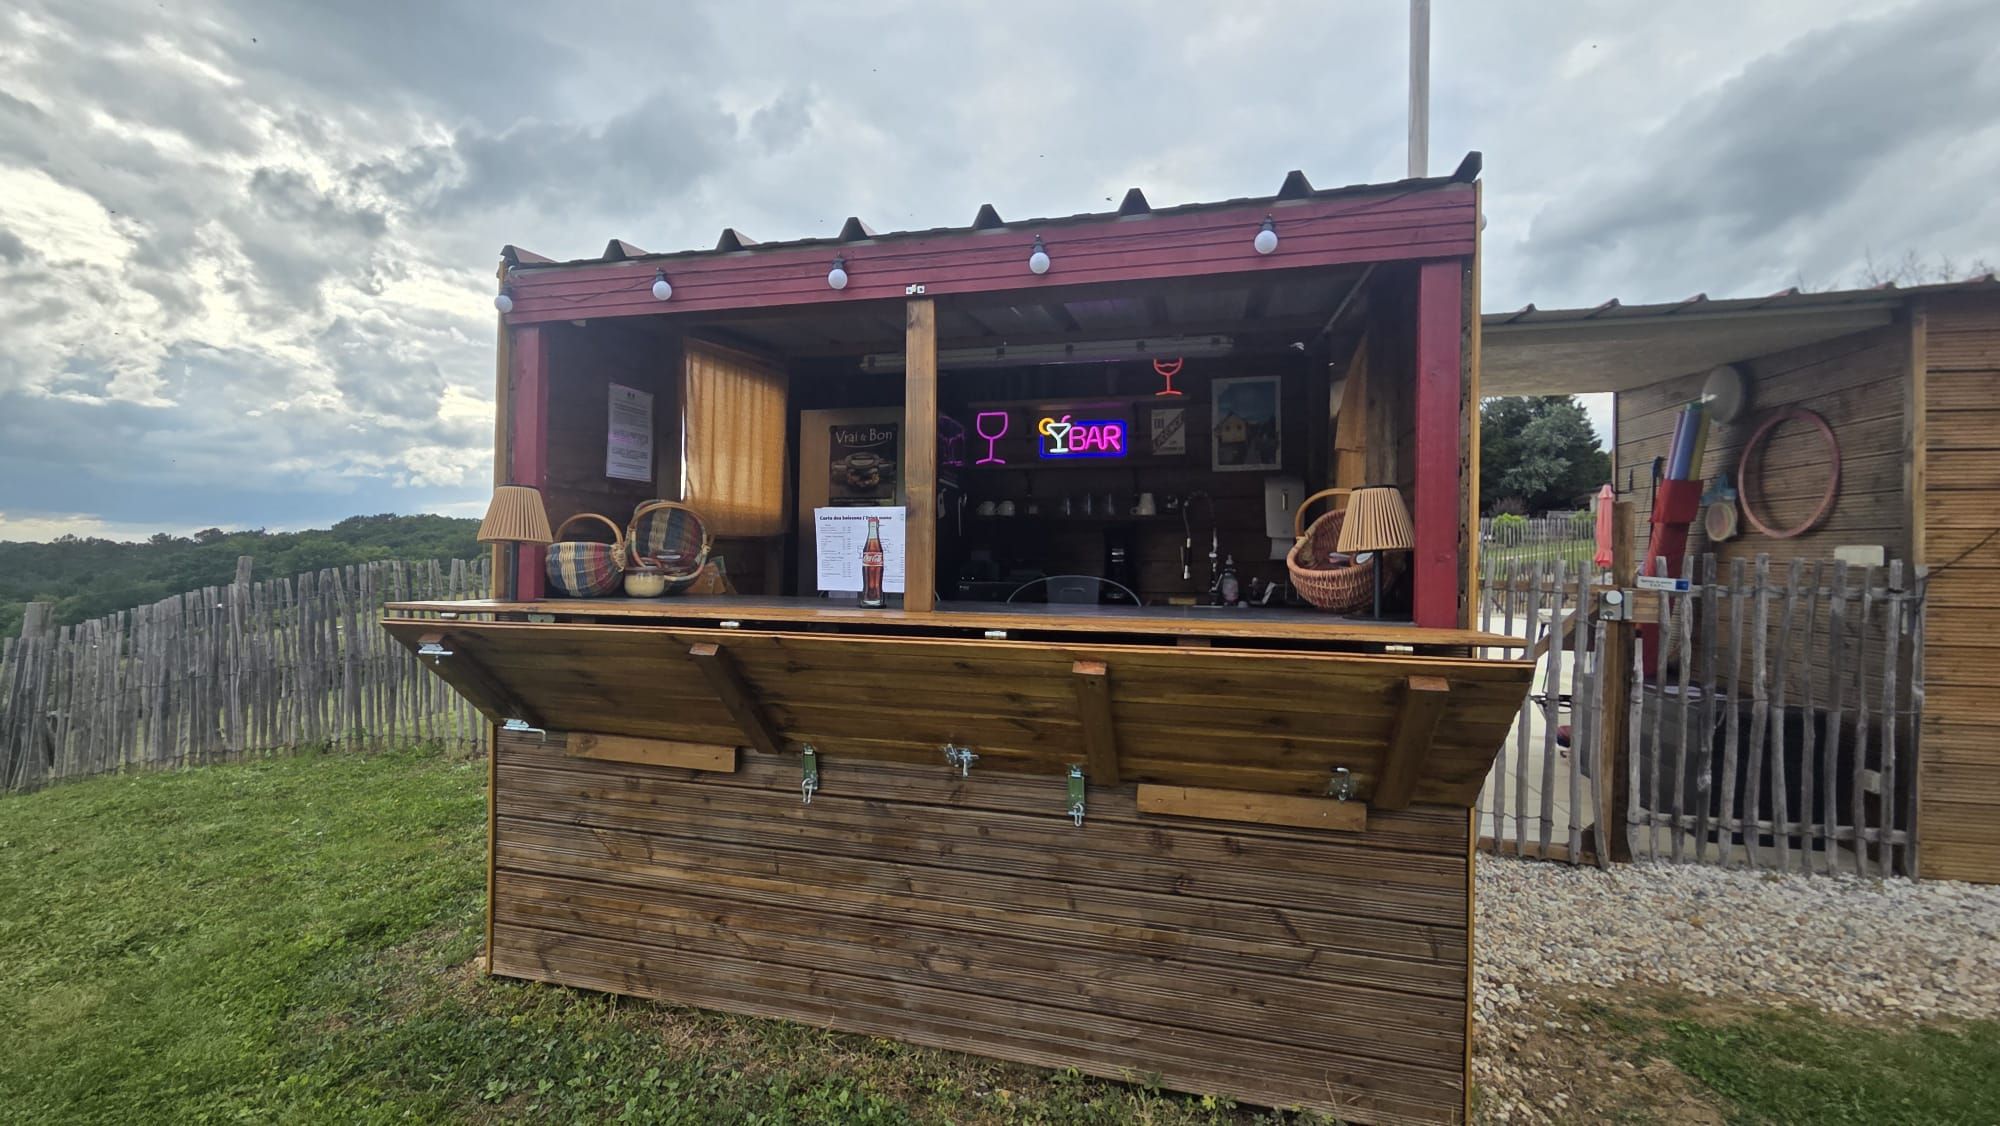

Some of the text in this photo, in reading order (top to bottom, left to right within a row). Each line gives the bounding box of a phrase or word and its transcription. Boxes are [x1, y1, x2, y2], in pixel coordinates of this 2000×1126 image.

[835, 431, 858, 444] Vrai
[869, 428, 893, 441] Bon
[1069, 425, 1121, 451] BAR
